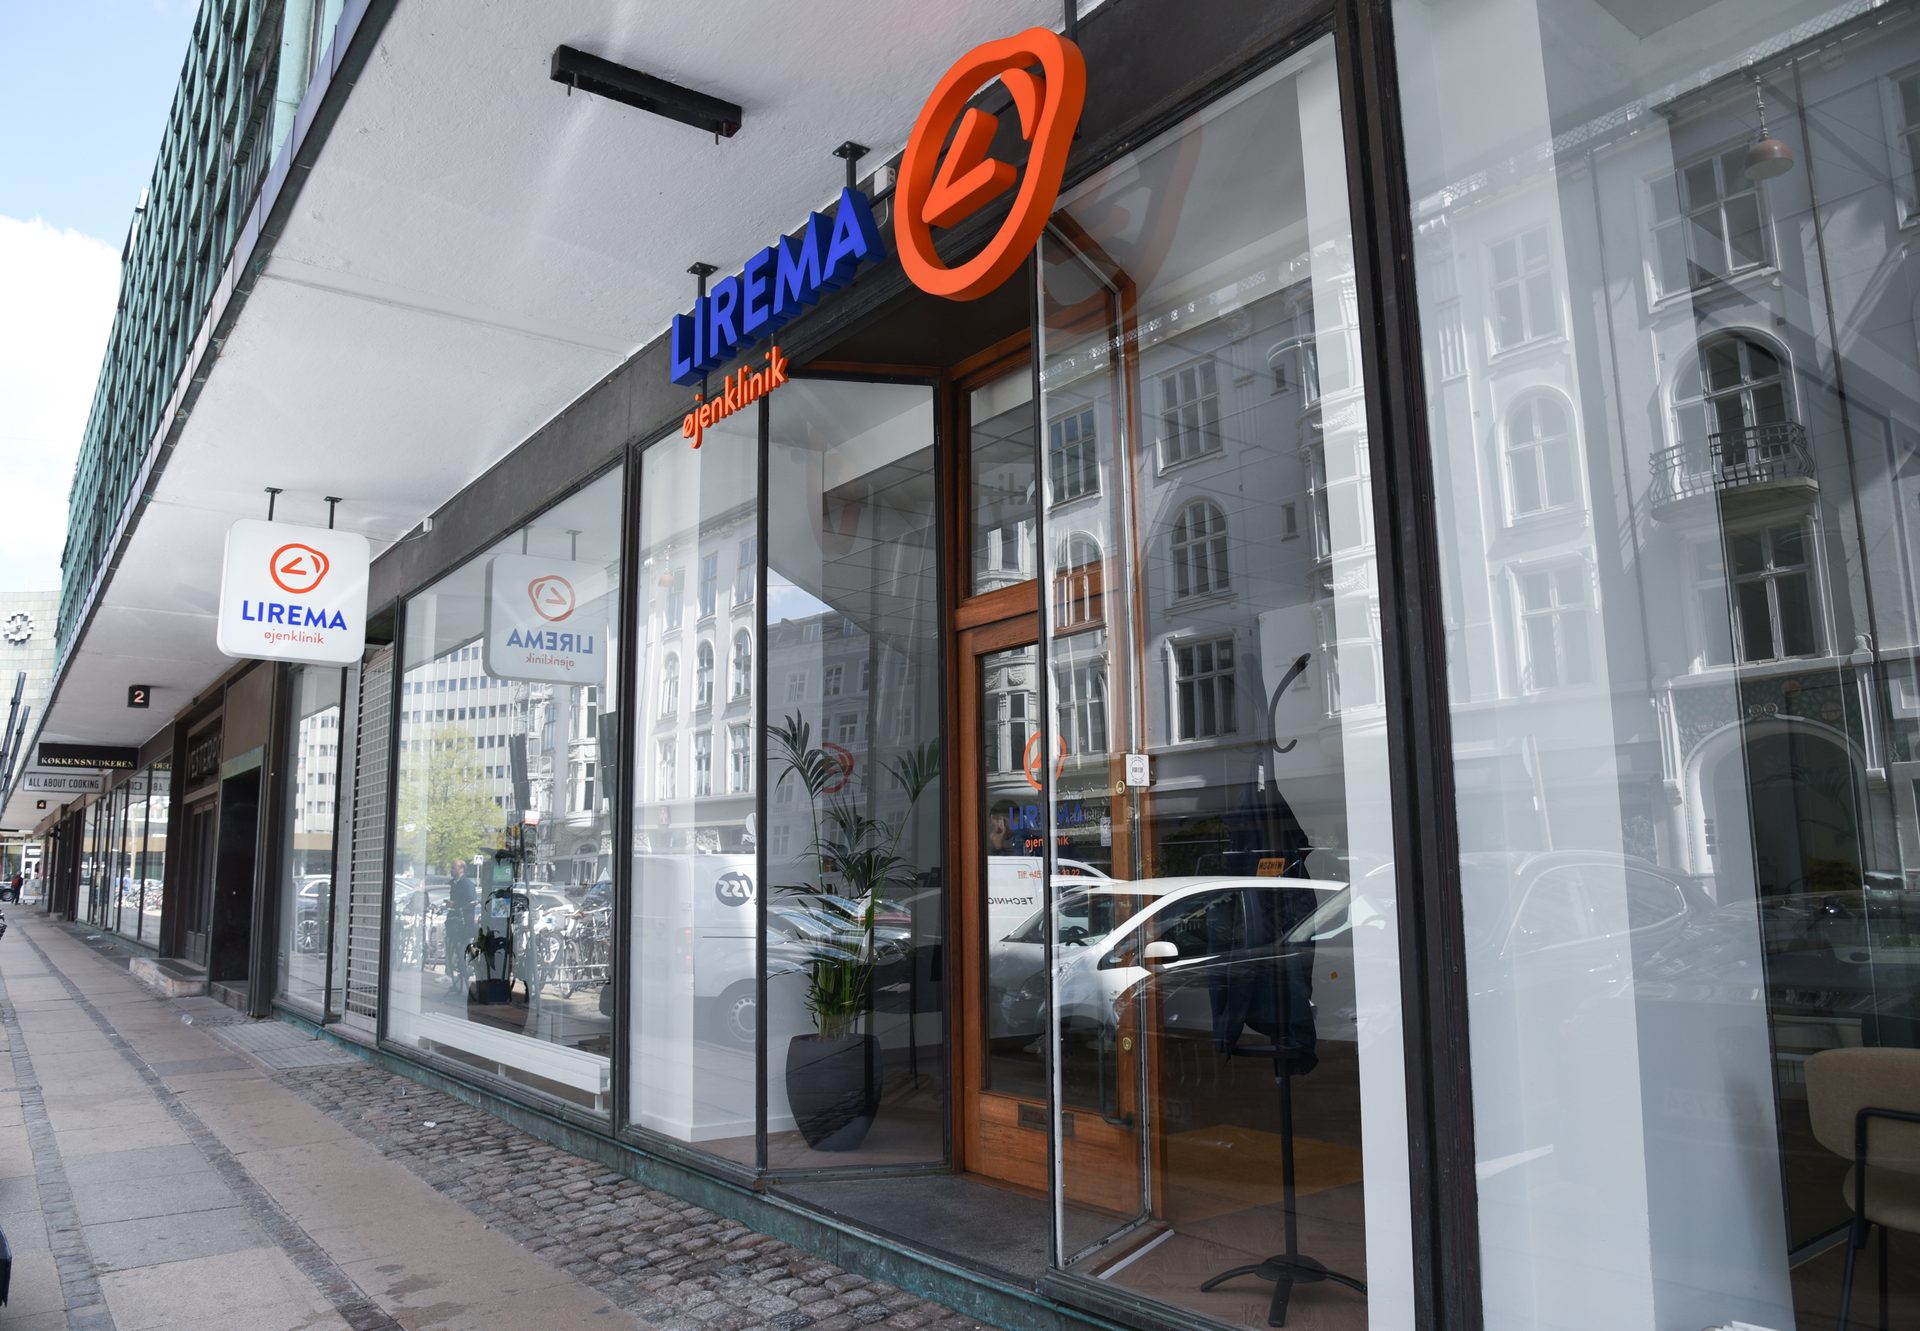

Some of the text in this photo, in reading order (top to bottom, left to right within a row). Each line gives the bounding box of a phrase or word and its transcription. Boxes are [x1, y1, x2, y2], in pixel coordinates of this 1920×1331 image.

[671, 187, 876, 386] LIREMA
[682, 345, 791, 449] øjenklinik
[242, 600, 348, 631] LIREMA
[264, 630, 325, 646] øjenklinik
[134, 690, 144, 703] 2
[41, 756, 134, 769] KØKKENSNEDKEREN
[28, 777, 99, 790] ALL ABOUT COOKING
[1025, 835, 1069, 853] øjennik
